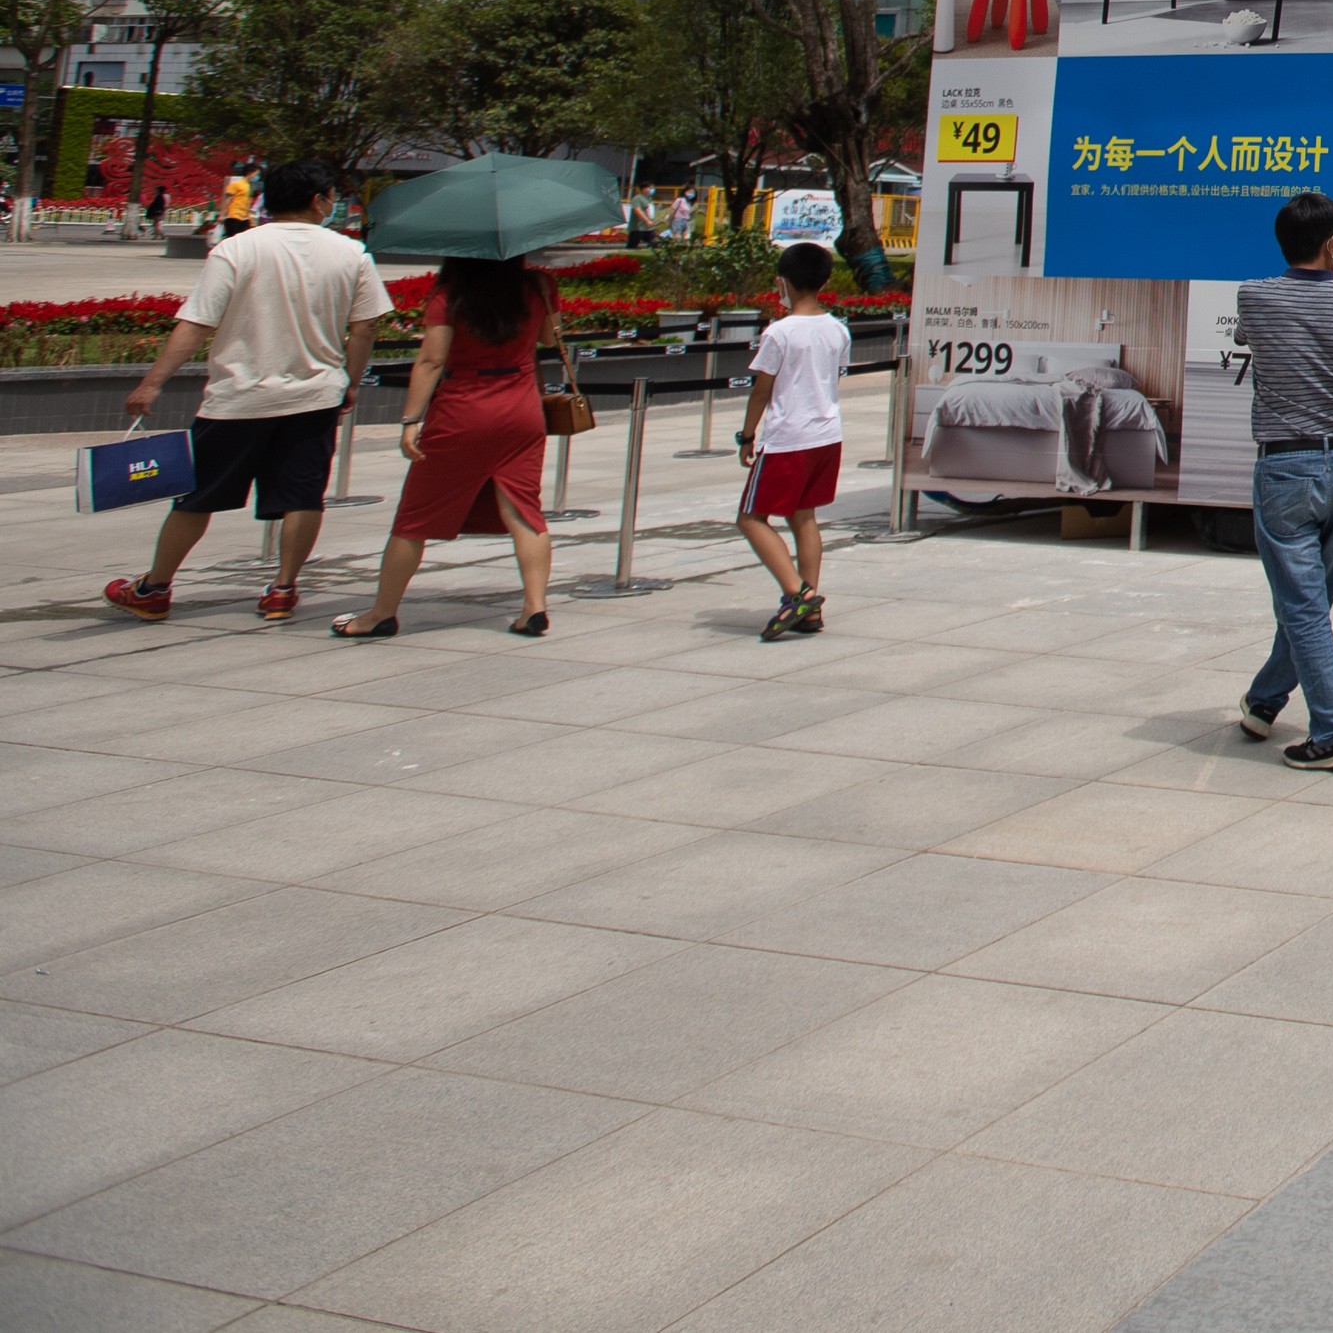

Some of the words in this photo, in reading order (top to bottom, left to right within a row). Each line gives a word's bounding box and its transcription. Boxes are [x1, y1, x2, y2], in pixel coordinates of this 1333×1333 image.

[942, 89, 963, 97] LACK
[965, 88, 981, 98] 拉克
[941, 99, 958, 108] 边桌
[960, 99, 994, 108] 55x55cm
[998, 98, 1014, 108] 黑色
[952, 121, 1001, 154] ¥49
[1072, 136, 1329, 173] 为每一个人而设计
[926, 307, 951, 316] MALM
[953, 307, 978, 317] 马尔姆
[1216, 316, 1240, 325] JOKK
[928, 339, 1013, 375] ¥1299
[1220, 350, 1252, 385] ¥7
[129, 459, 159, 472] HLA
